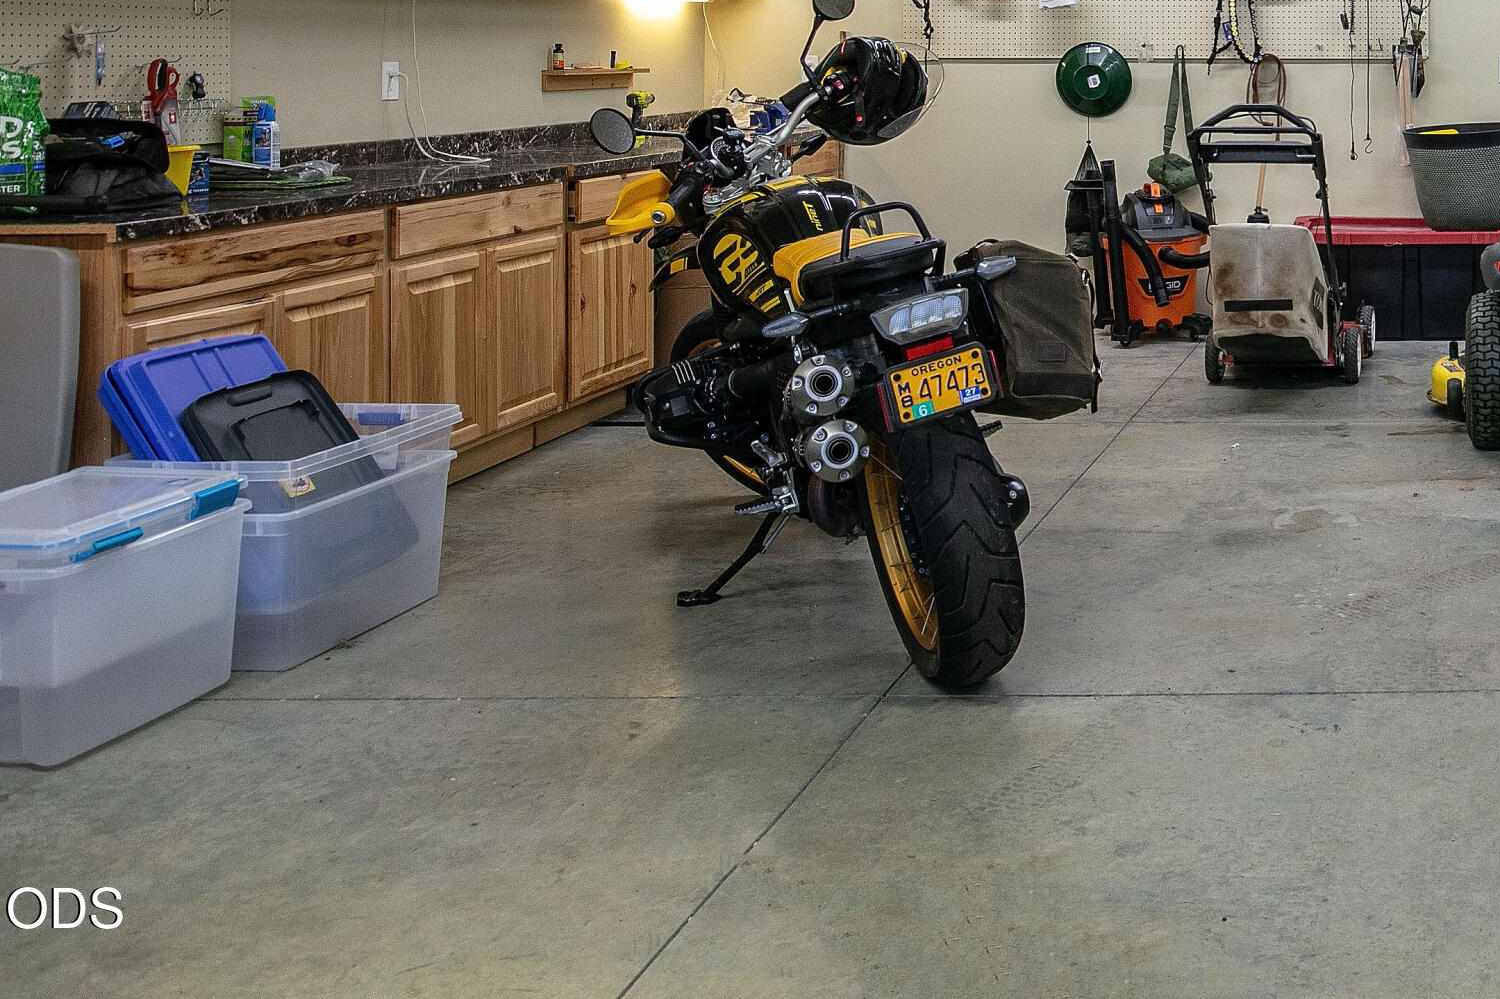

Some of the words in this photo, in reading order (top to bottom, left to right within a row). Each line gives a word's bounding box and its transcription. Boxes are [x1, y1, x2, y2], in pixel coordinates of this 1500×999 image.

[911, 355, 962, 377] OREGON
[919, 362, 986, 400] 47473
[964, 387, 977, 397] 27
[918, 404, 928, 417] 6
